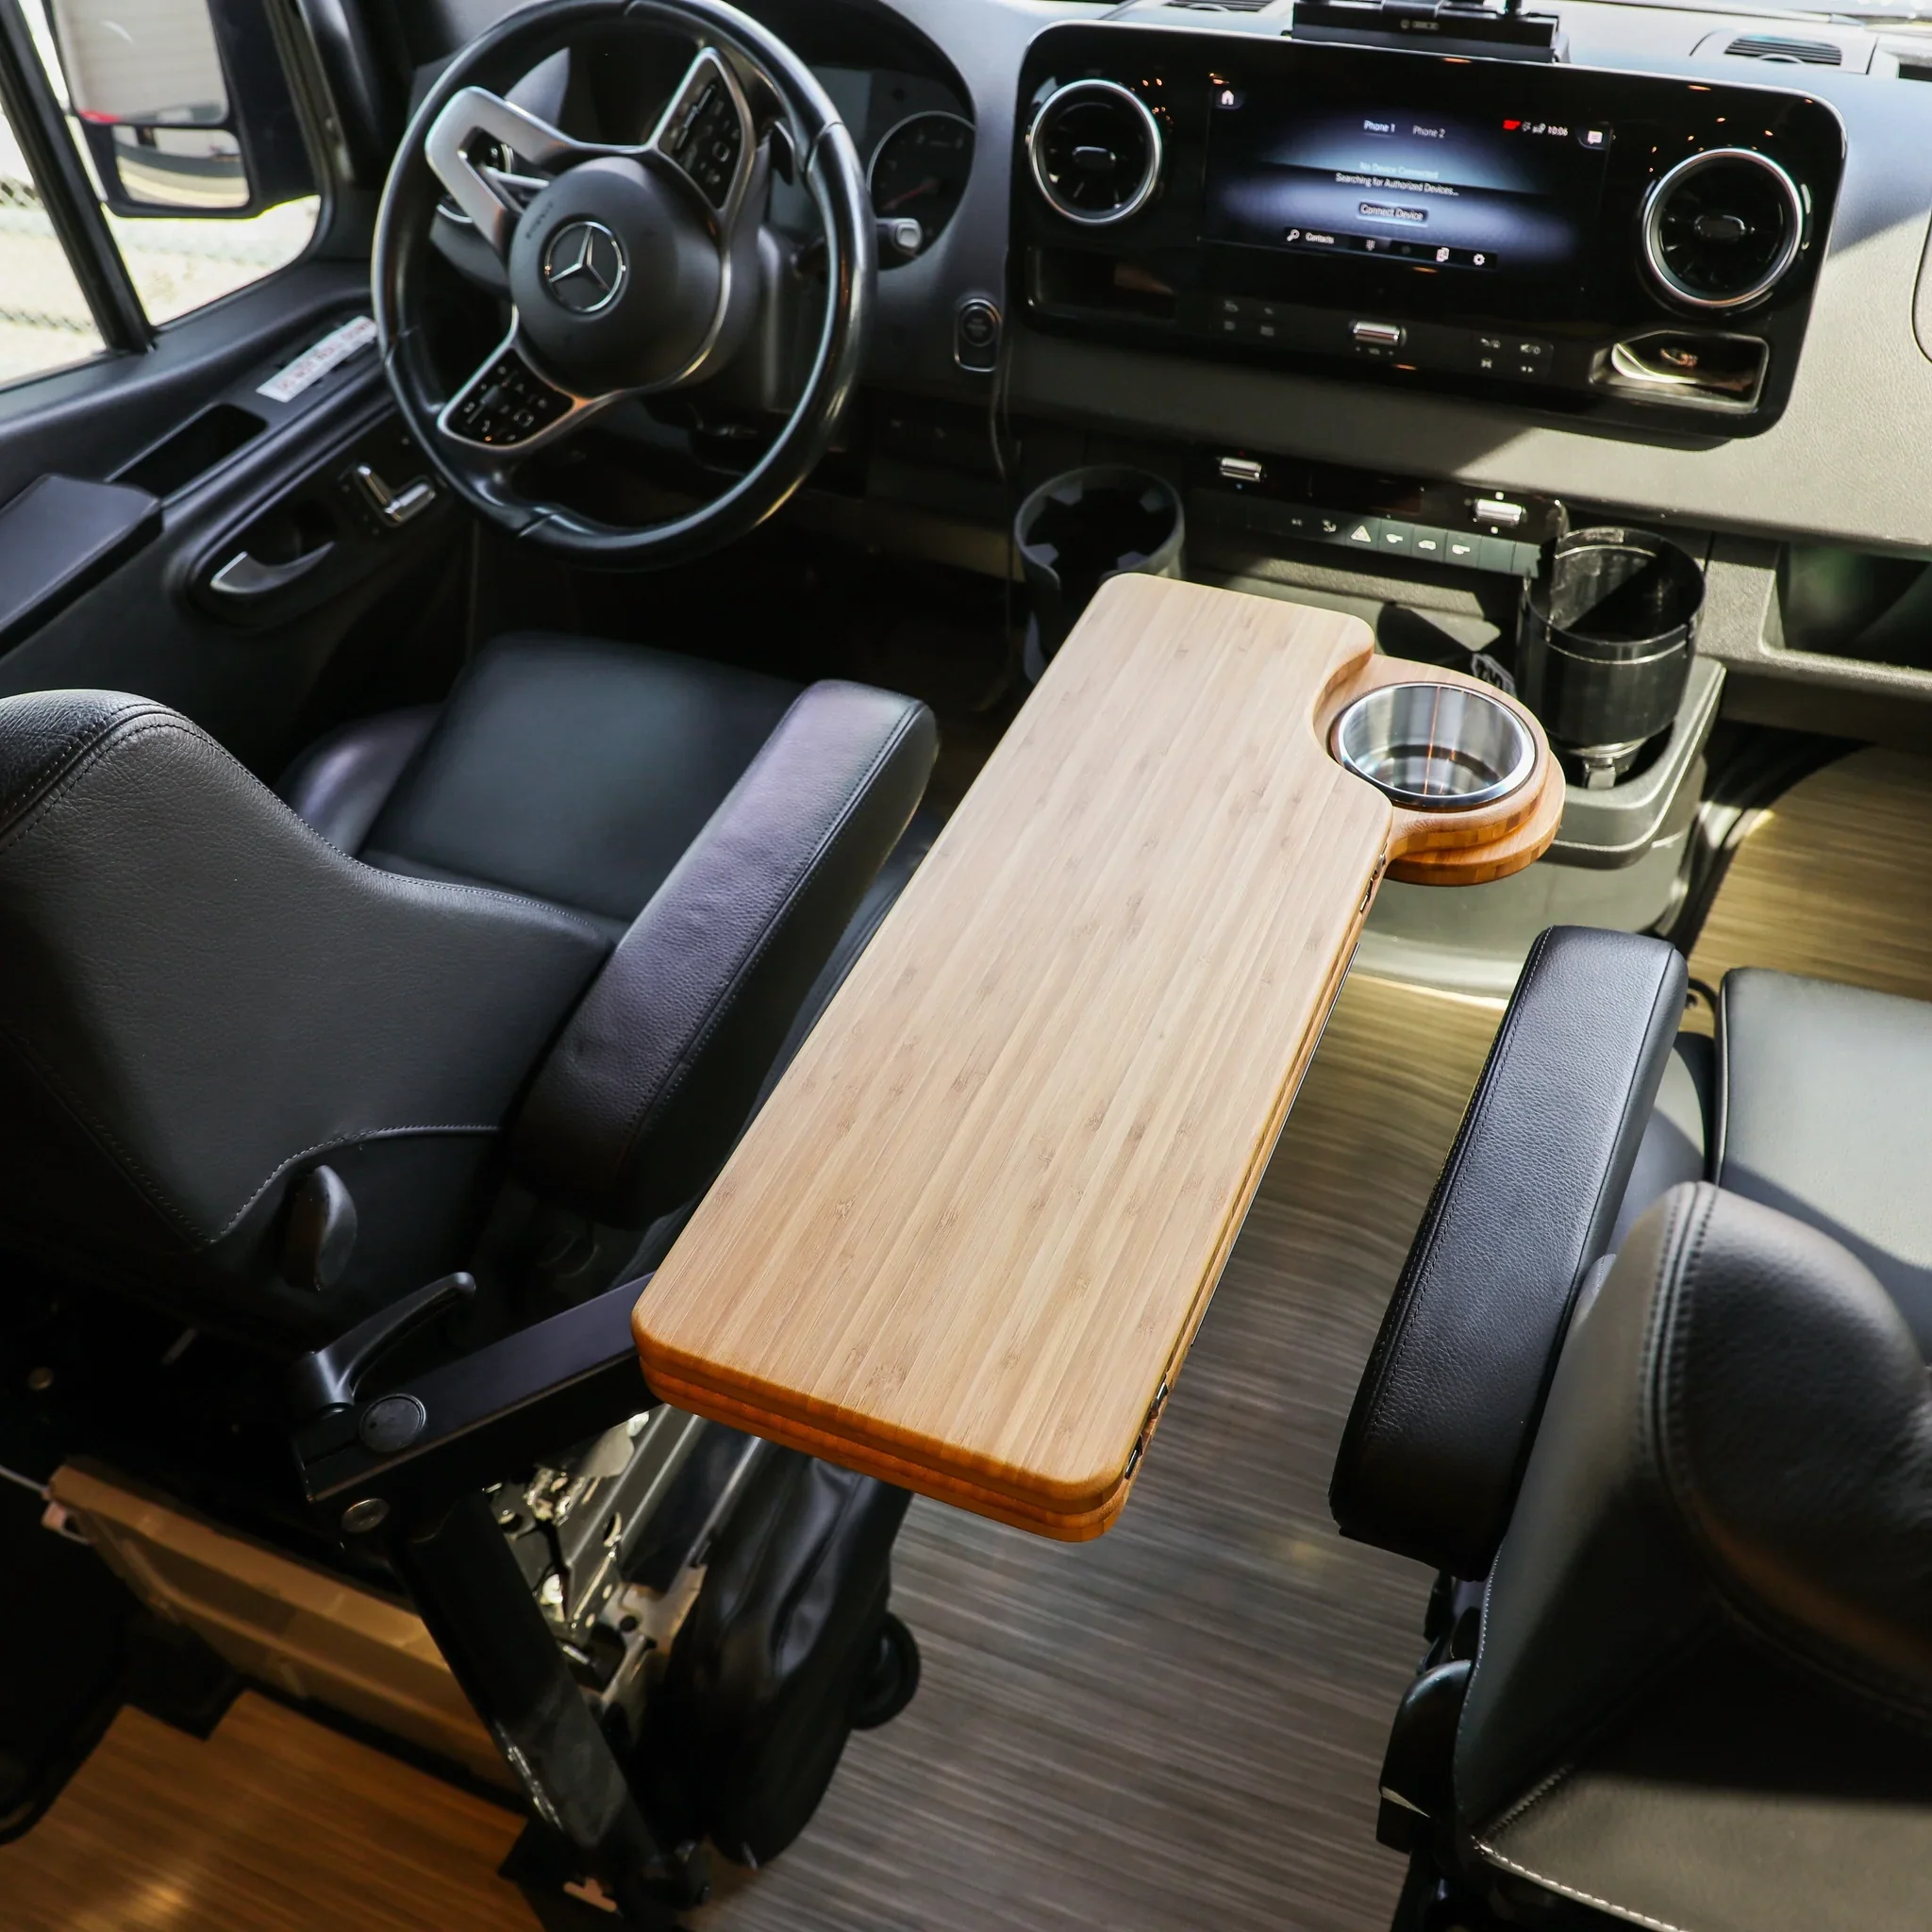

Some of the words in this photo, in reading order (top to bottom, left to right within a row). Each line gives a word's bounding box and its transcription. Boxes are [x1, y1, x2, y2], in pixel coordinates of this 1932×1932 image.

[1364, 120, 1390, 131] Phone
[1413, 125, 1438, 137] Phone
[1336, 173, 1372, 188] Searching
[1373, 176, 1384, 186] for
[1384, 178, 1423, 192] Authorized
[1360, 204, 1394, 216] Connect
[1396, 208, 1424, 220] Device
[1306, 232, 1334, 243] Contacts
